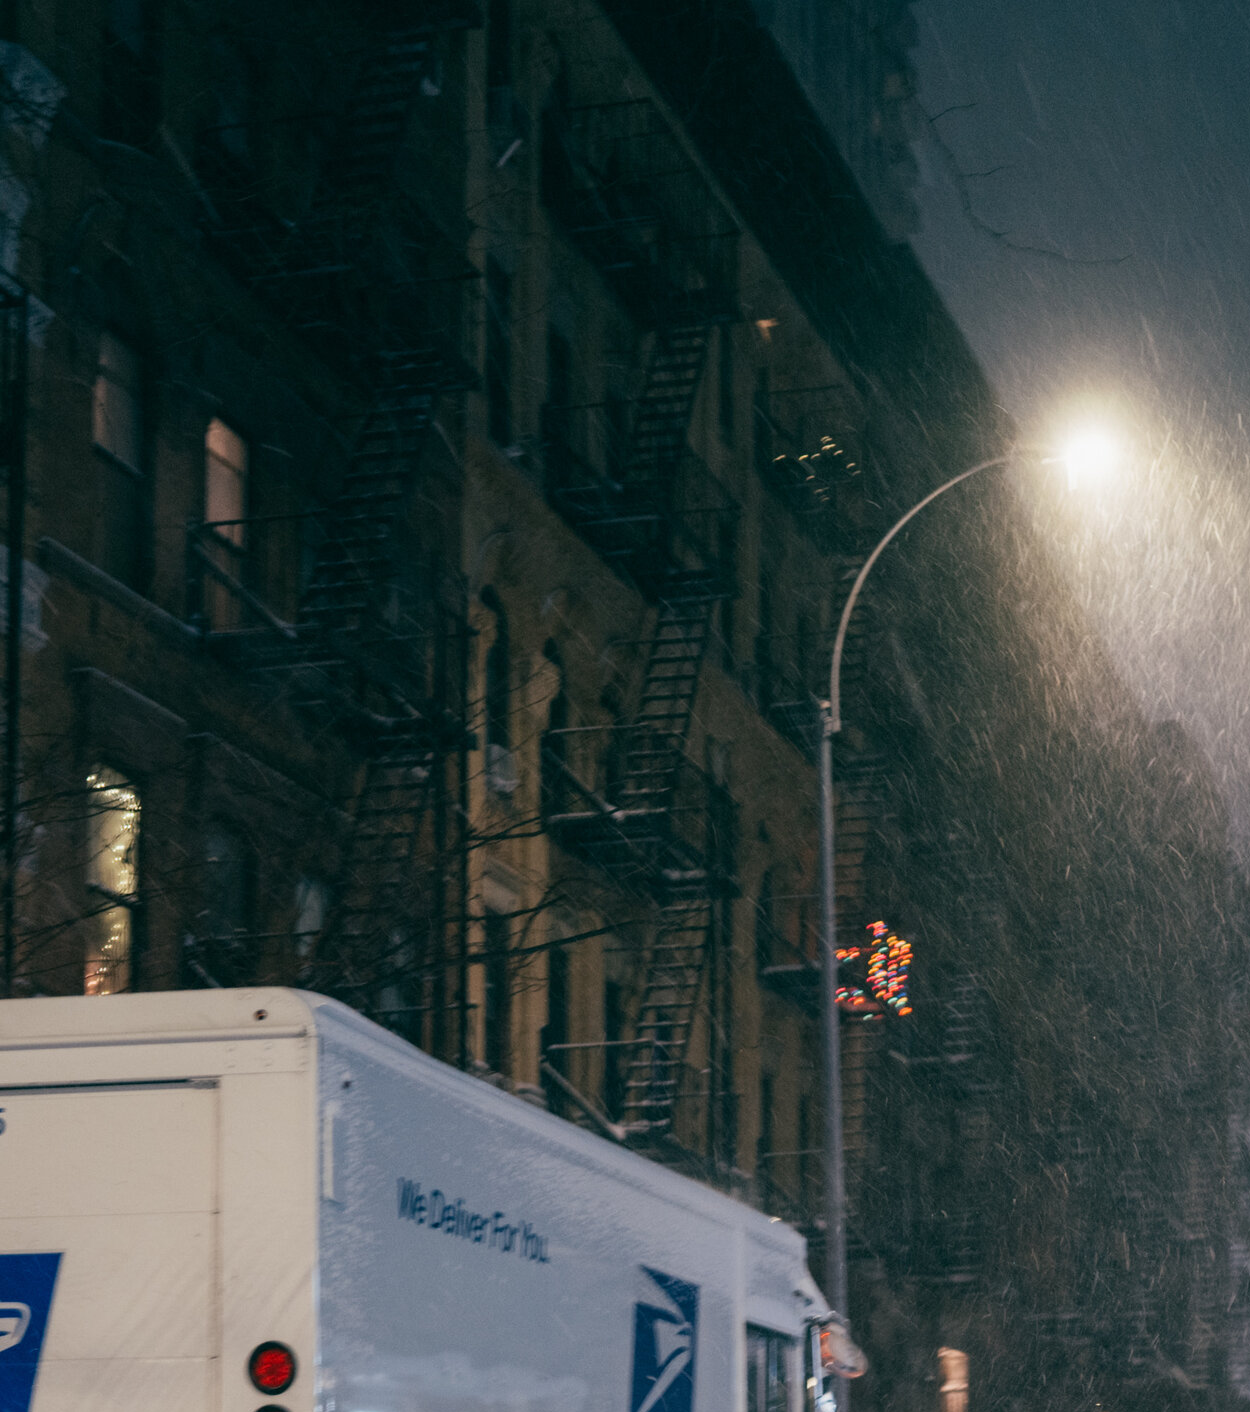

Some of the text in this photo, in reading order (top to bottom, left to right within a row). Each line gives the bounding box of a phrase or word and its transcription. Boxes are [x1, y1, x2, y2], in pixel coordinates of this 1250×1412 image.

[396, 1176, 427, 1224] We
[429, 1189, 489, 1243] Deliver
[489, 1211, 519, 1252] For
